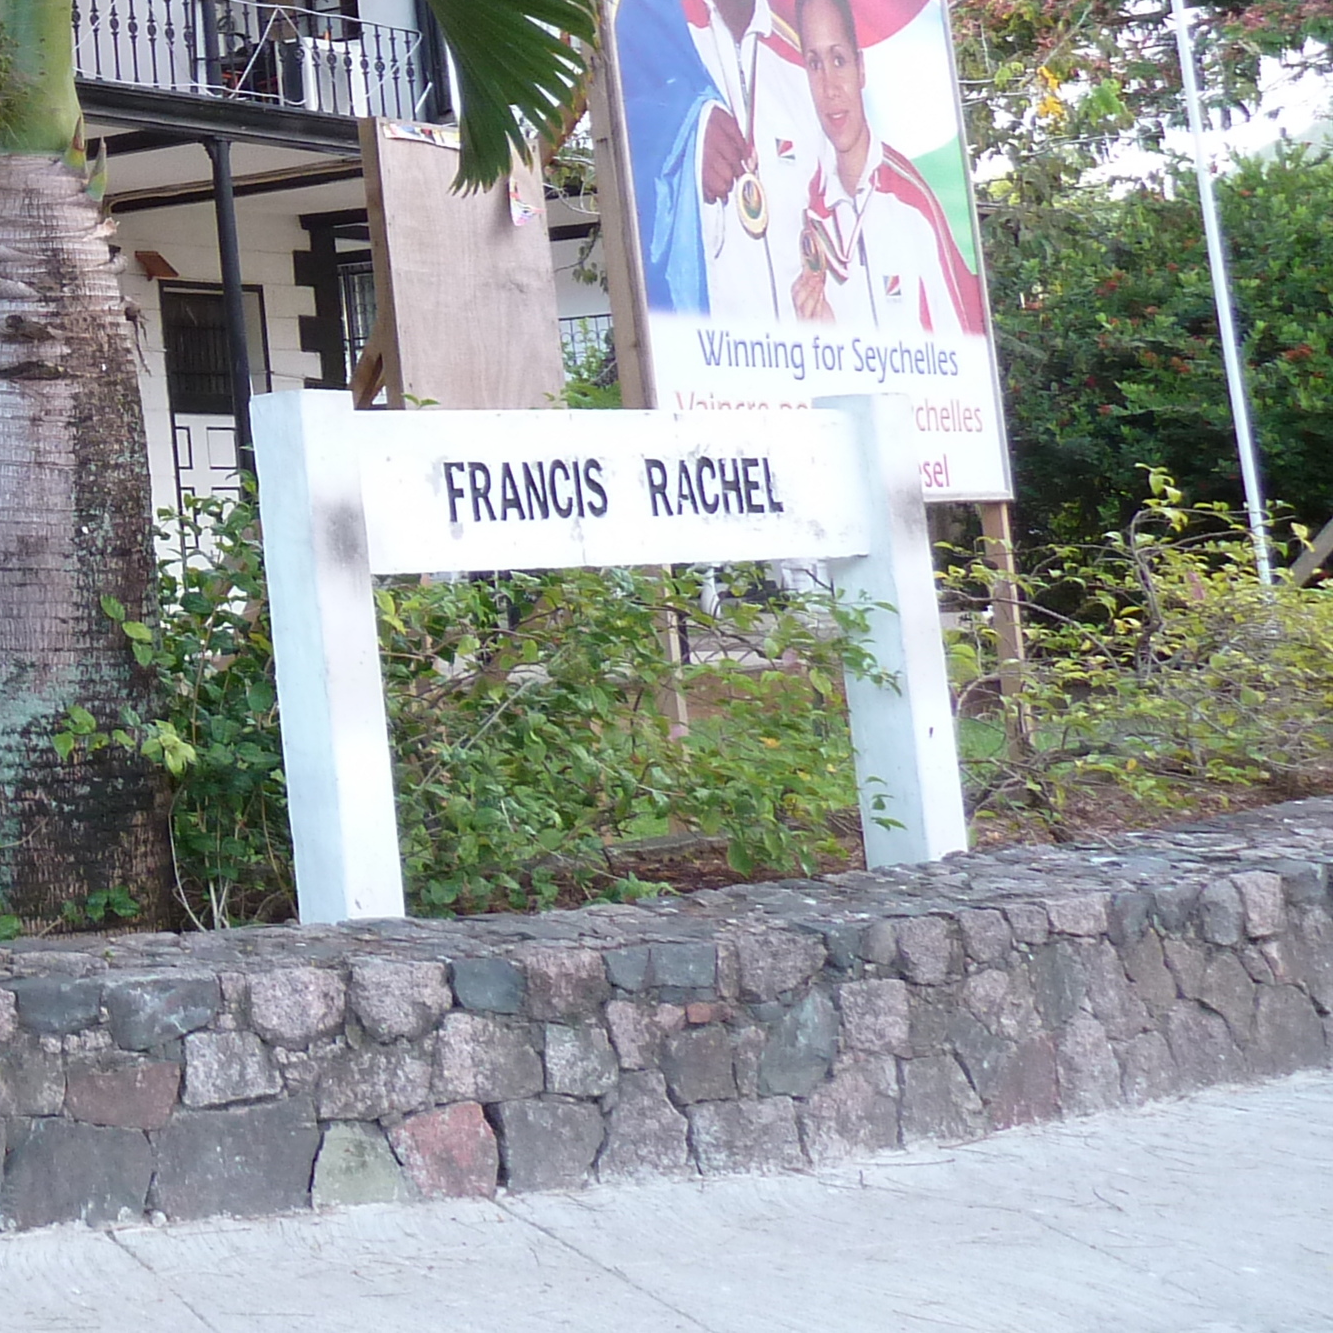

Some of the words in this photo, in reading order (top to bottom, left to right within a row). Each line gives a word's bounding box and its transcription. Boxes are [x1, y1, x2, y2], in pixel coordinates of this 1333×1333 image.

[697, 329, 806, 381] Winning
[812, 335, 845, 371] for
[851, 338, 959, 384] Seychelles
[912, 397, 983, 433] chelles
[442, 458, 608, 523] FRANCIS
[643, 455, 784, 517] RACHEL
[919, 452, 951, 488] sel
